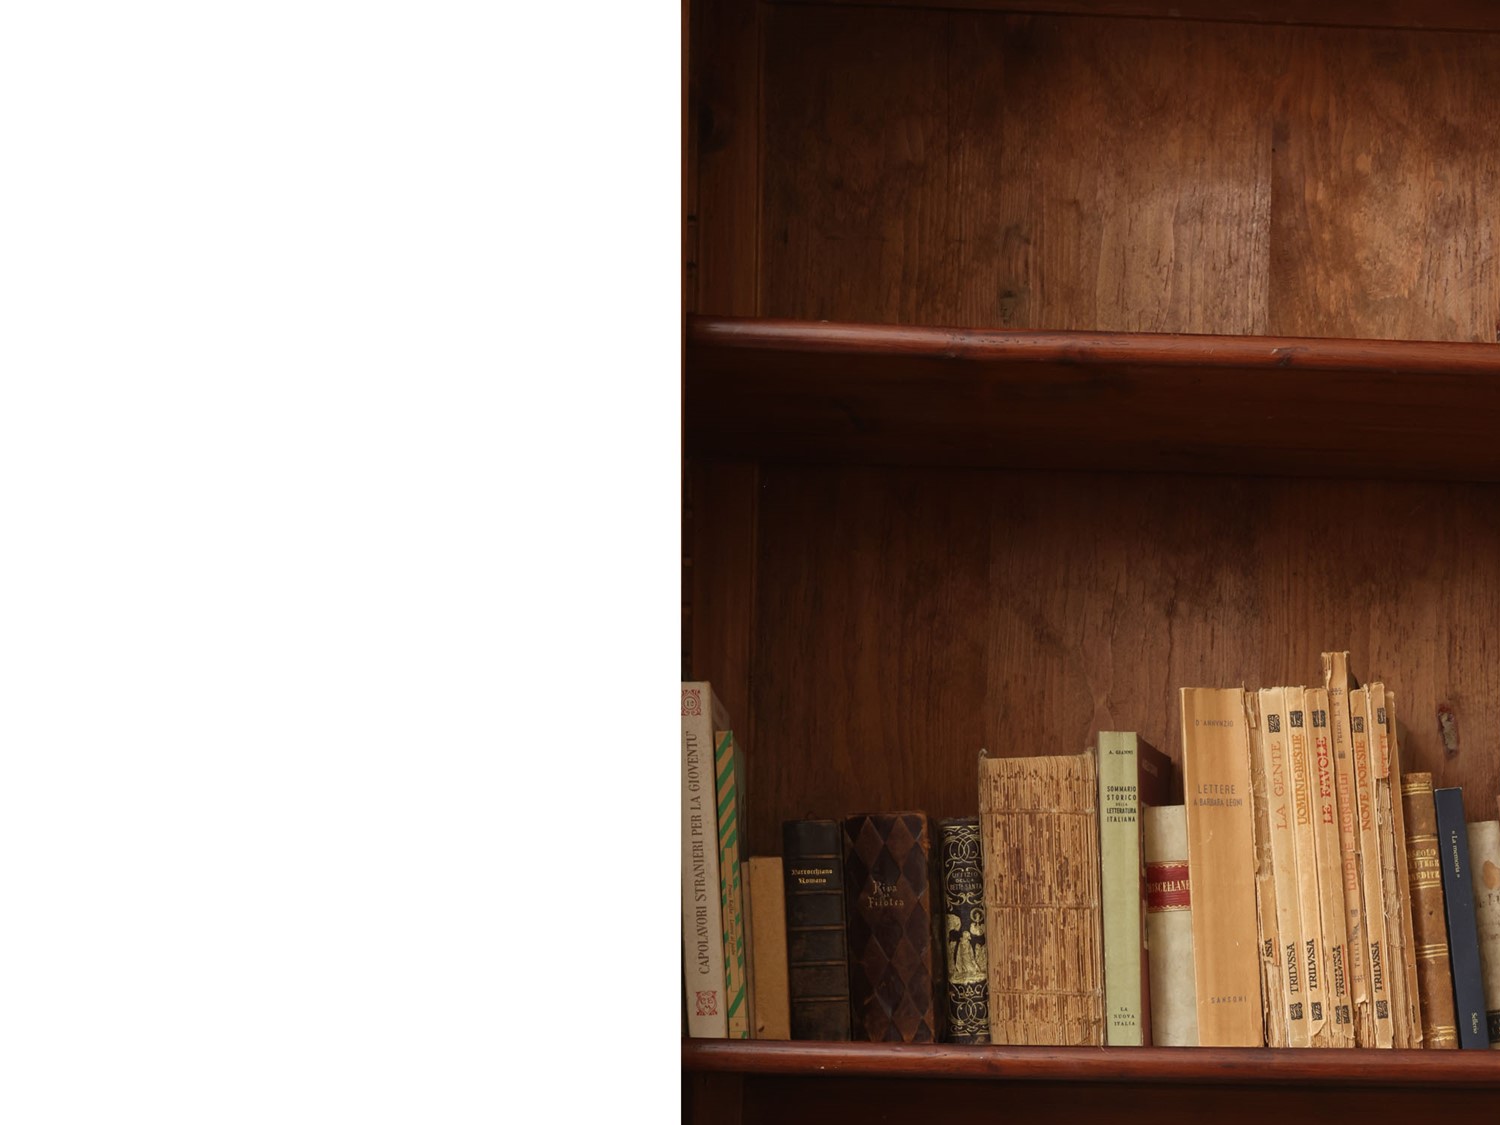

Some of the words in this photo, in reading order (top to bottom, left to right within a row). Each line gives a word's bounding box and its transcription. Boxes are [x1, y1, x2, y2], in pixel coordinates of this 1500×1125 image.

[1271, 741, 1285, 797] GENTE
[1292, 734, 1304, 773] BESTIE
[1316, 736, 1331, 798] FAVOLE
[1355, 741, 1368, 789] POESIE
[690, 796, 701, 810] LA
[1197, 784, 1236, 794] LETTERE
[1199, 798, 1224, 806] BARBARA
[1296, 780, 1308, 826] UOMINI
[691, 815, 703, 837] PER
[1276, 804, 1287, 830] LA
[1322, 804, 1334, 824] LE
[1359, 791, 1371, 832] NOVE
[693, 840, 706, 900] STRANIERI
[1452, 845, 1460, 873] memoria
[696, 905, 710, 975] CAPOLAVORI
[1287, 942, 1299, 995] TRILVSSA
[1306, 939, 1318, 991] TRILVSSA
[1371, 941, 1383, 993] TRILVSSA
[1210, 995, 1247, 1004] SANSONI
[1470, 1010, 1479, 1034] Sellerio
